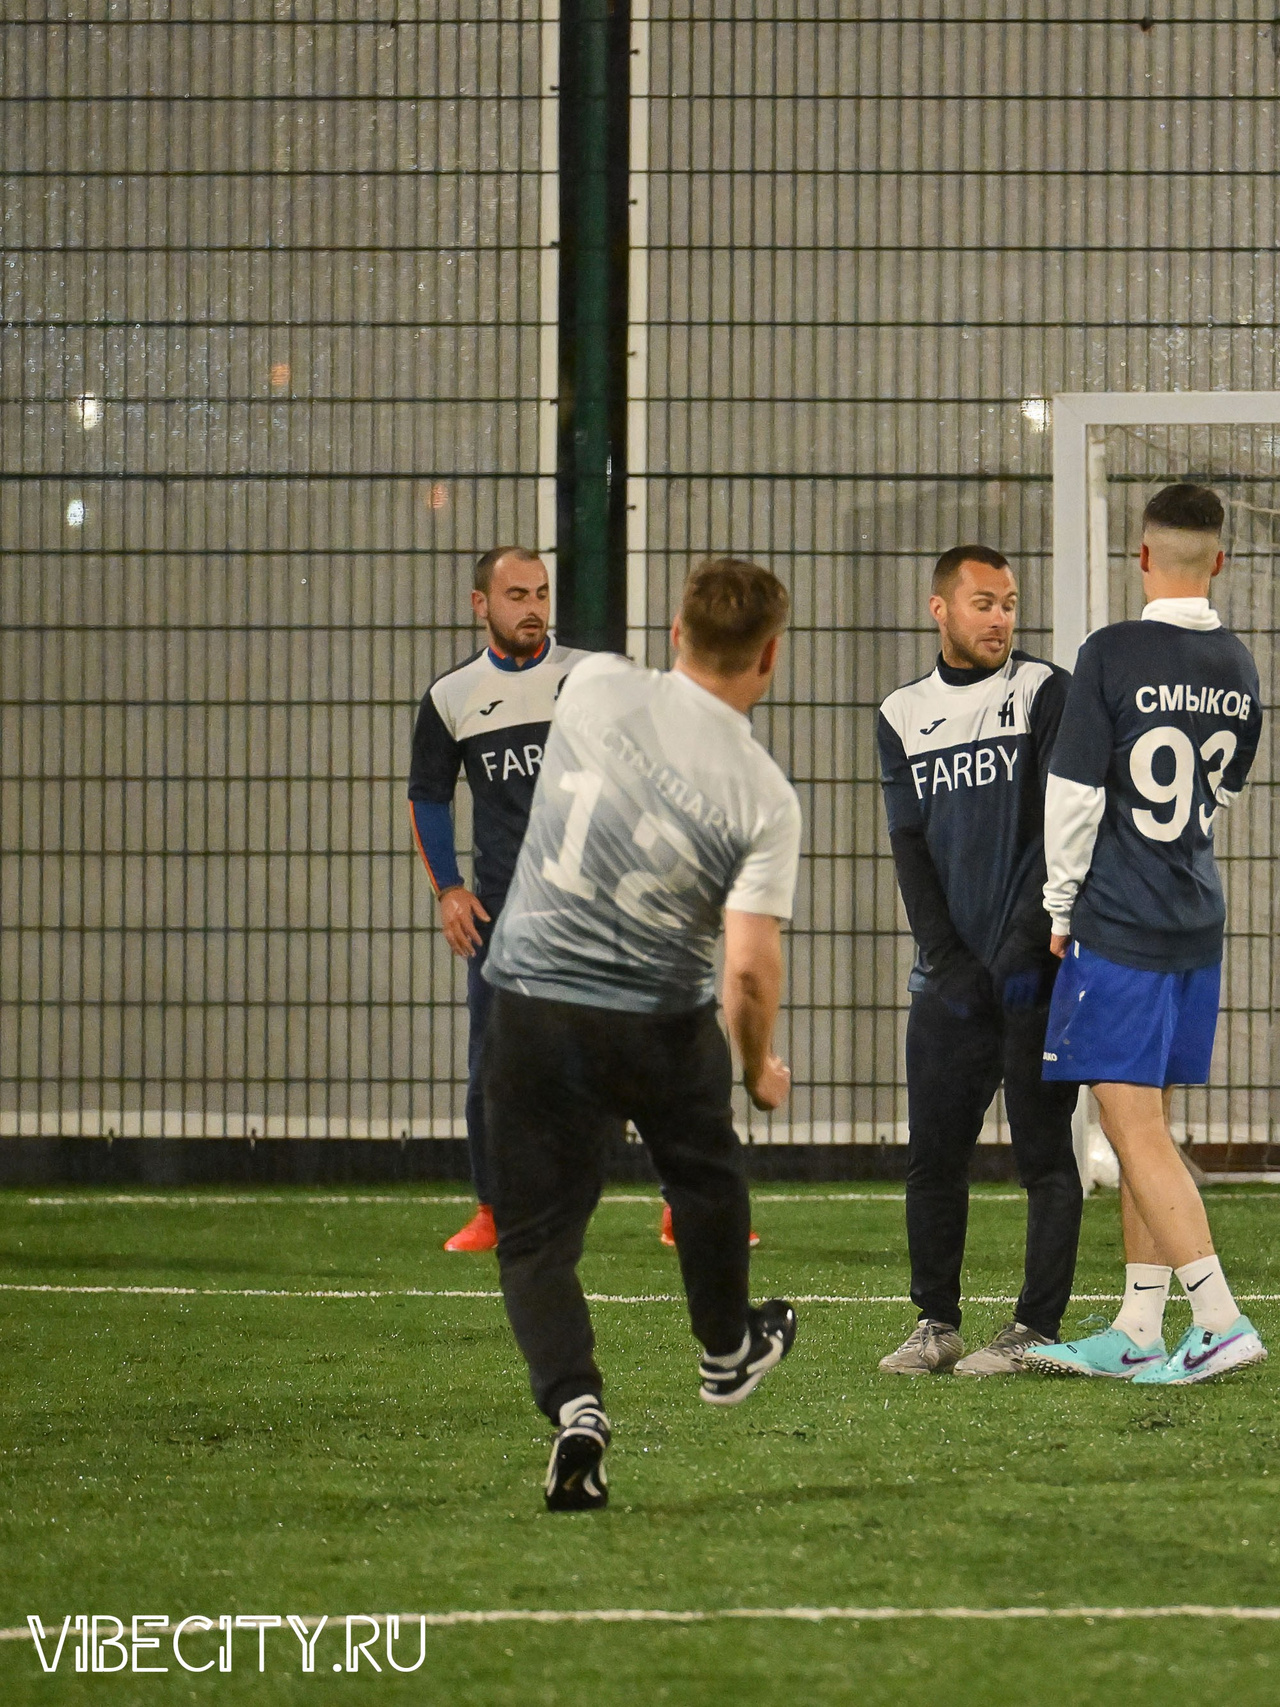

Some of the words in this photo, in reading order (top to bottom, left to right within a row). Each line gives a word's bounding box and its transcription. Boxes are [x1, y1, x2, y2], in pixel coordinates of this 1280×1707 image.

[1135, 684, 1252, 721] СМЫКОВ
[481, 743, 544, 782] FAR
[910, 745, 1018, 800] FARBY
[1129, 725, 1238, 843] 93
